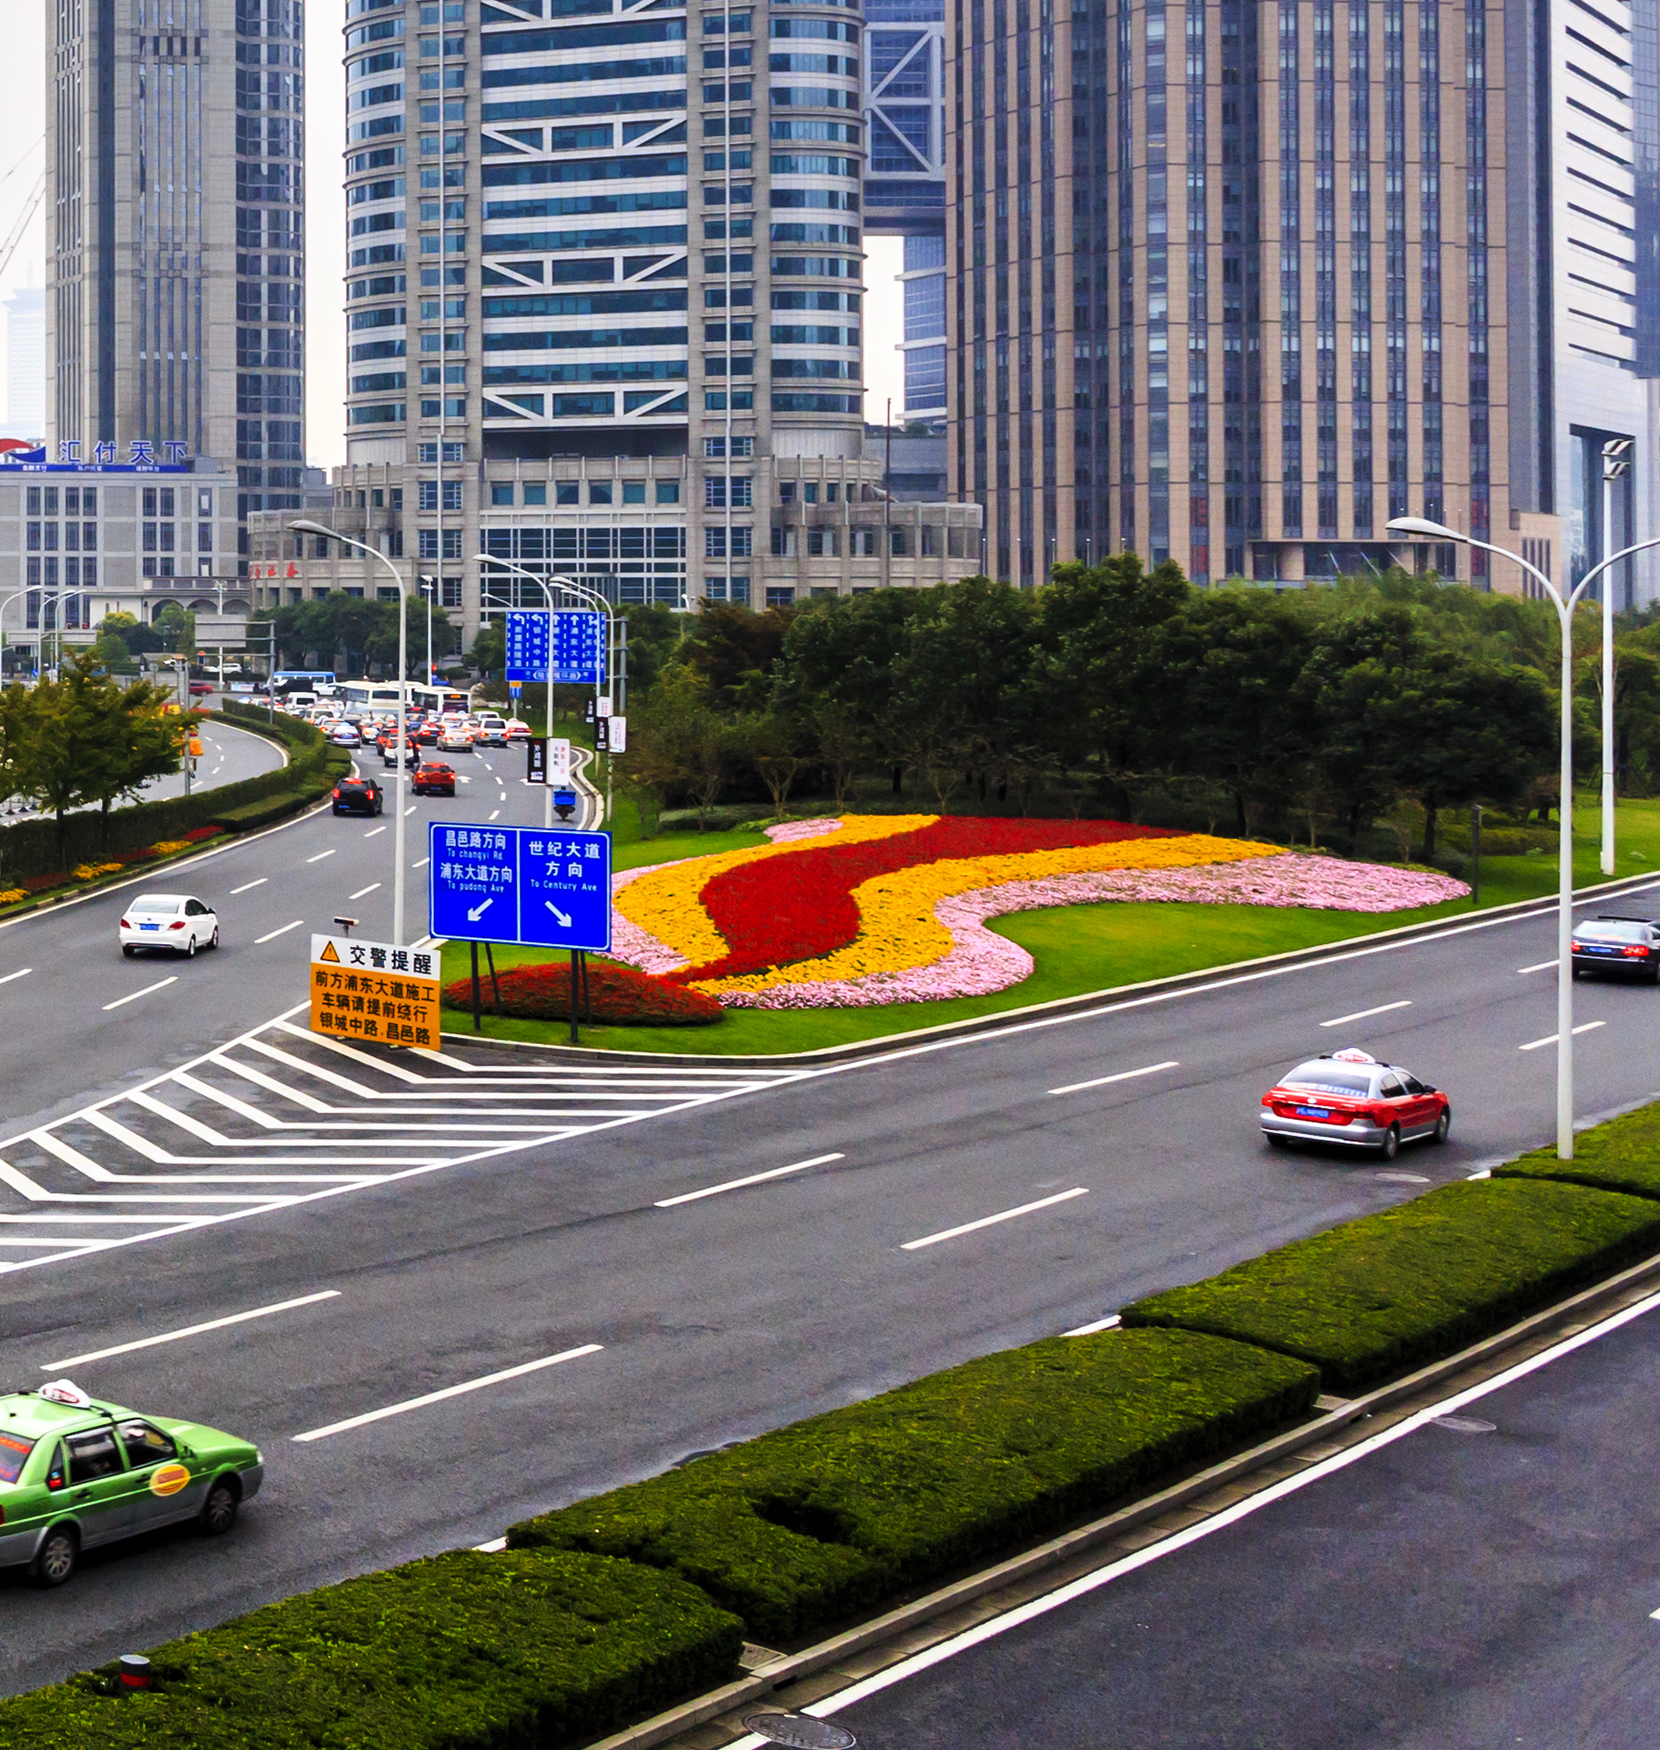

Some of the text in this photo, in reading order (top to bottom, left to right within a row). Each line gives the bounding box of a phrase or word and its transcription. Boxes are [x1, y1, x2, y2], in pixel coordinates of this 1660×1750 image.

[59, 439, 187, 465] 汇付天下
[445, 830, 506, 850] 昌邑路方向
[529, 840, 601, 859] 世纪大道
[447, 849, 456, 858] To
[459, 850, 490, 861] changyi
[440, 862, 513, 883] 浦东大道方向
[545, 861, 583, 878] 方向
[447, 880, 456, 890] To
[459, 882, 487, 894] pudong
[531, 879, 540, 888] To
[543, 880, 577, 892] Century
[349, 945, 432, 975] 交警提醒
[315, 970, 435, 1002] 前方浦东大道施工
[321, 992, 428, 1023] 车辆请提前绕行
